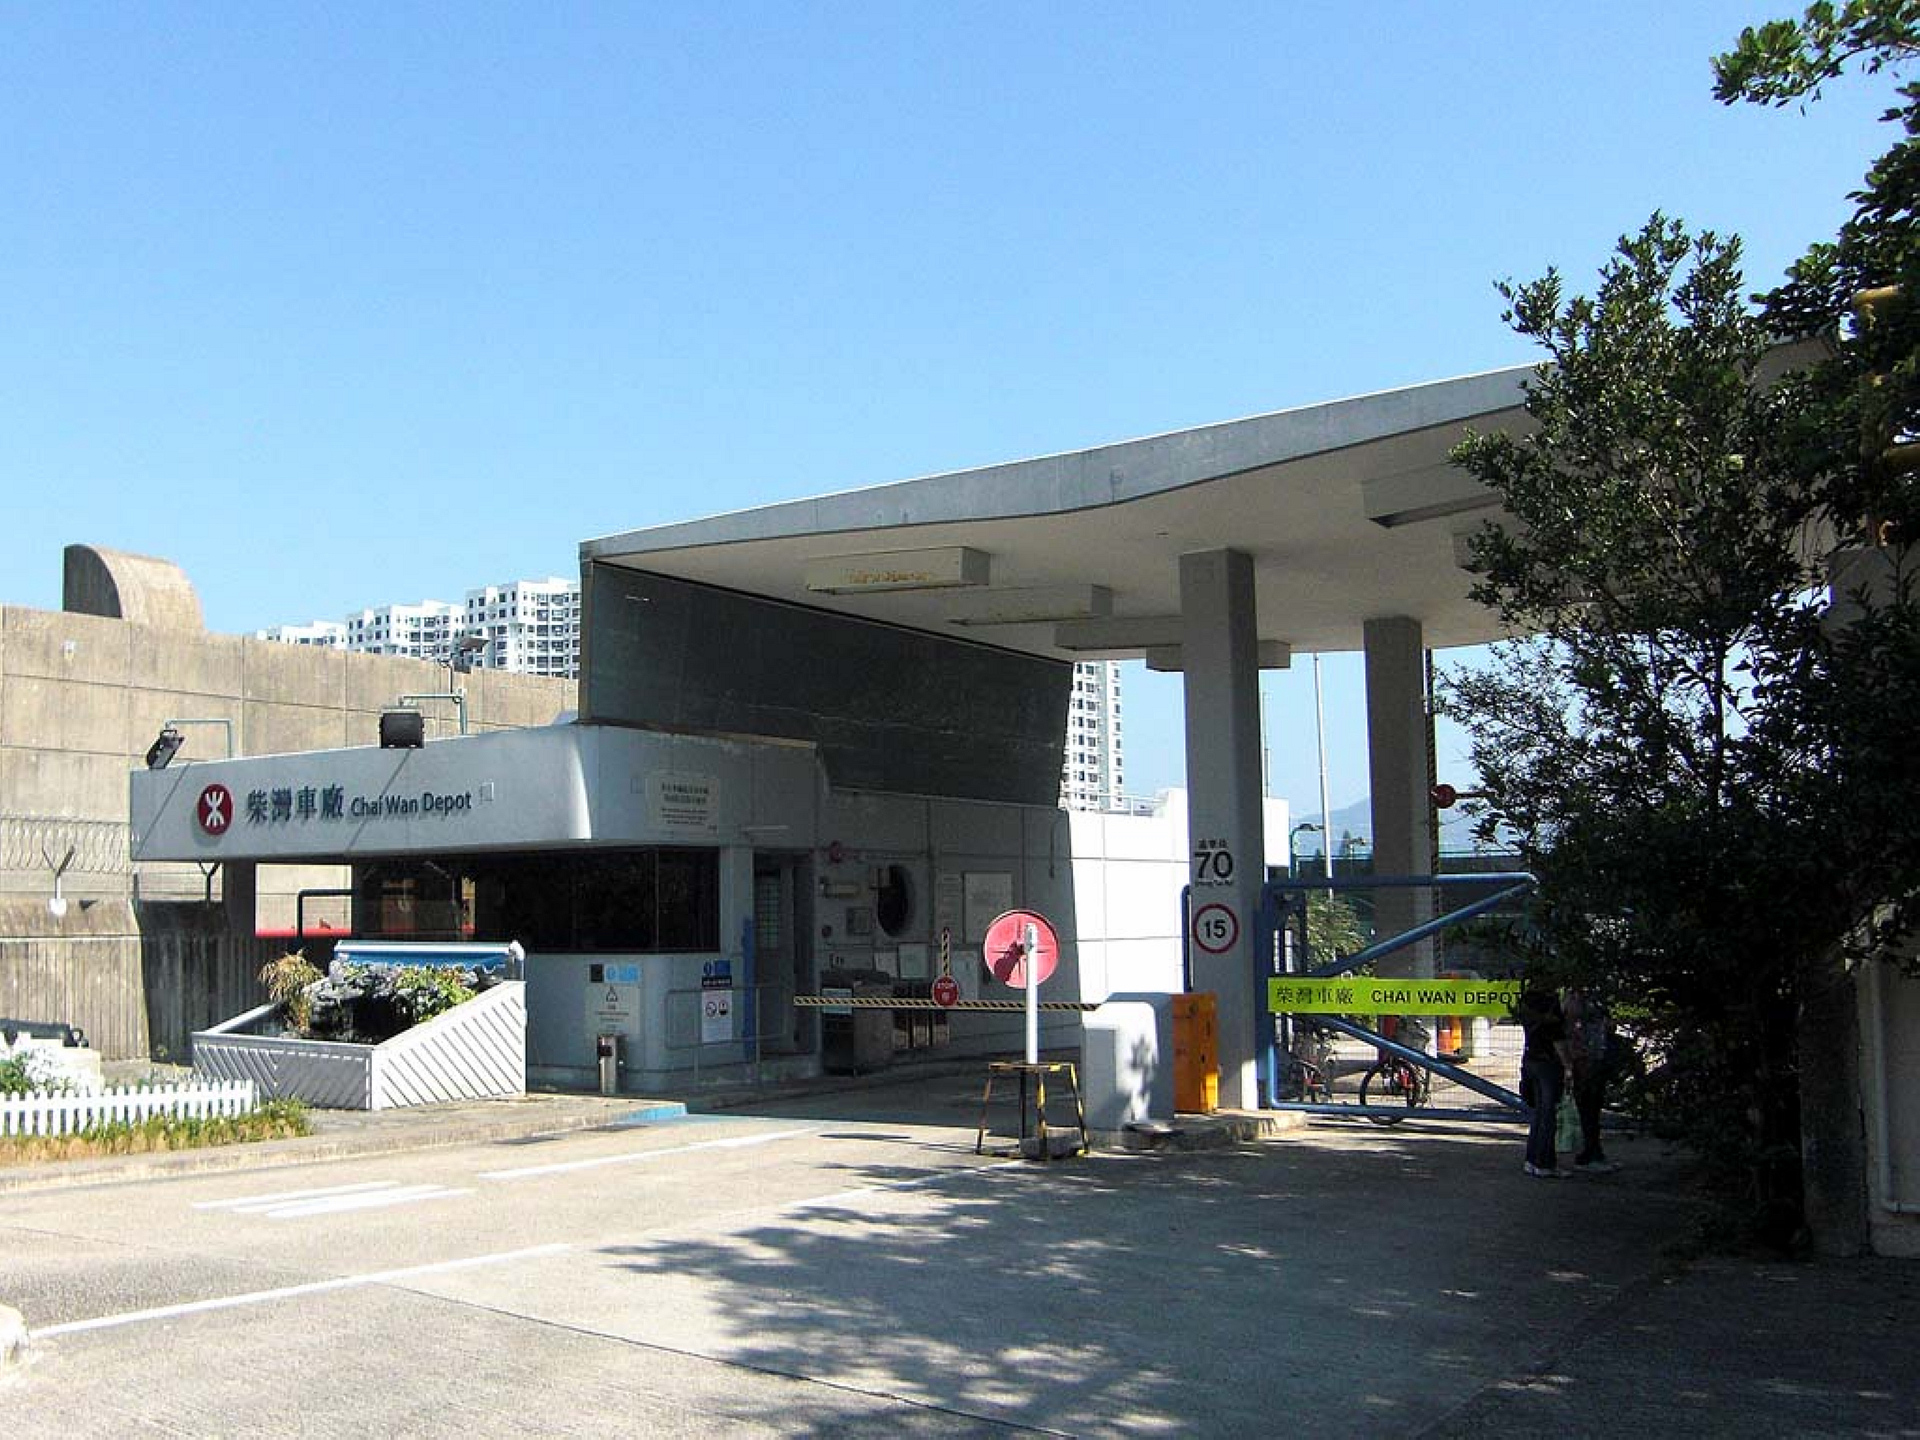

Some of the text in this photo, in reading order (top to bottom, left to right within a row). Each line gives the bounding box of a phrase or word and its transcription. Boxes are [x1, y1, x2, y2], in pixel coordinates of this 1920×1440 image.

[247, 783, 344, 823] 柴灣車廠
[350, 790, 472, 817] Chai Wan Depot
[1194, 851, 1234, 879] 70
[1204, 919, 1227, 939] 15
[1371, 989, 1522, 1006] CHAI WAN DEPOT
